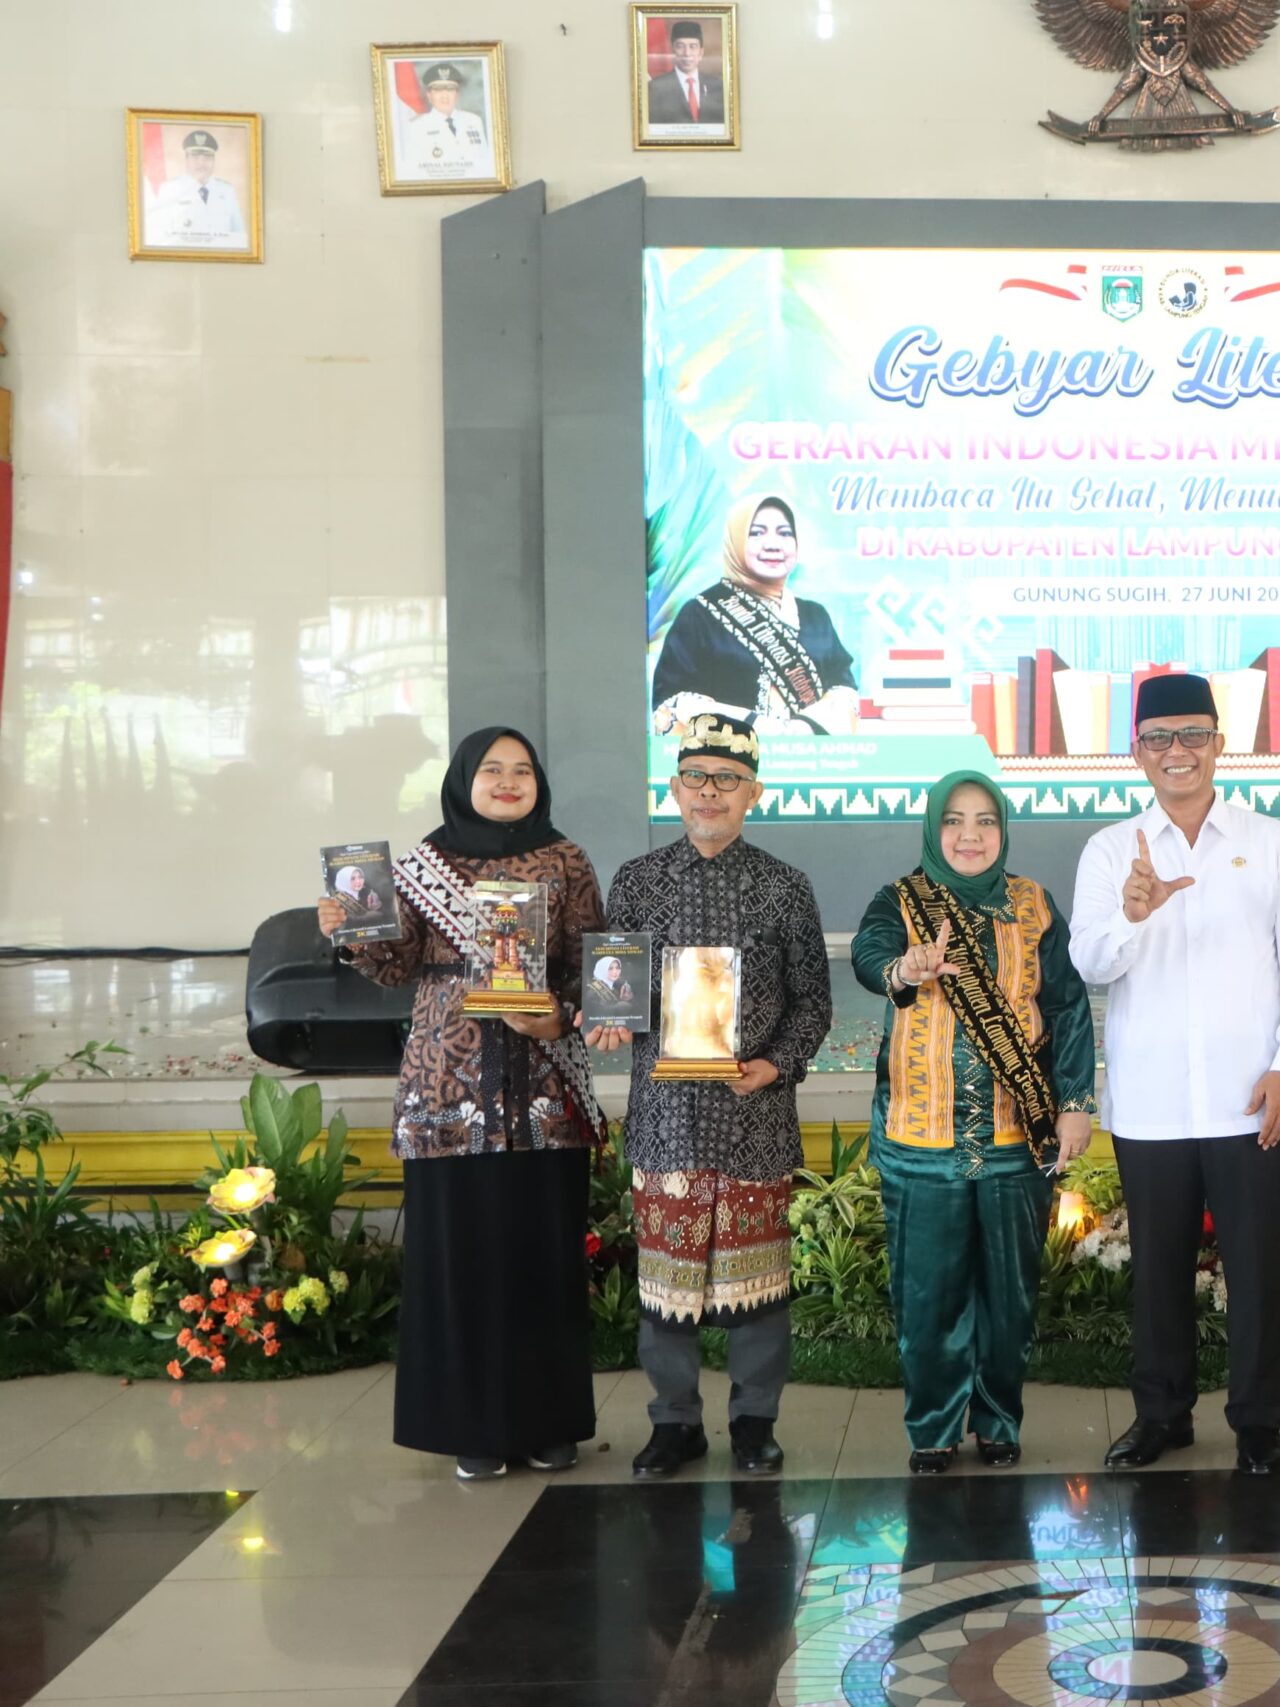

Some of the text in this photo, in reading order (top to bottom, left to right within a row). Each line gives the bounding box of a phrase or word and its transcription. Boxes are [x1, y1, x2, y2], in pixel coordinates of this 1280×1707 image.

[869, 325, 1154, 417] Gebyar
[732, 427, 953, 460] GERAKAN
[967, 428, 1218, 460] INDONESIA
[831, 475, 994, 511] Membaca
[859, 529, 895, 556] DI
[905, 529, 1115, 556] KABUPATEN
[1013, 587, 1101, 602] GUNUNG
[1181, 587, 1203, 602] 27
[1208, 587, 1251, 602] JUNI
[747, 621, 797, 667] Literasi
[980, 1015, 1023, 1076] Lampung
[1014, 1069, 1049, 1124] Tengah
